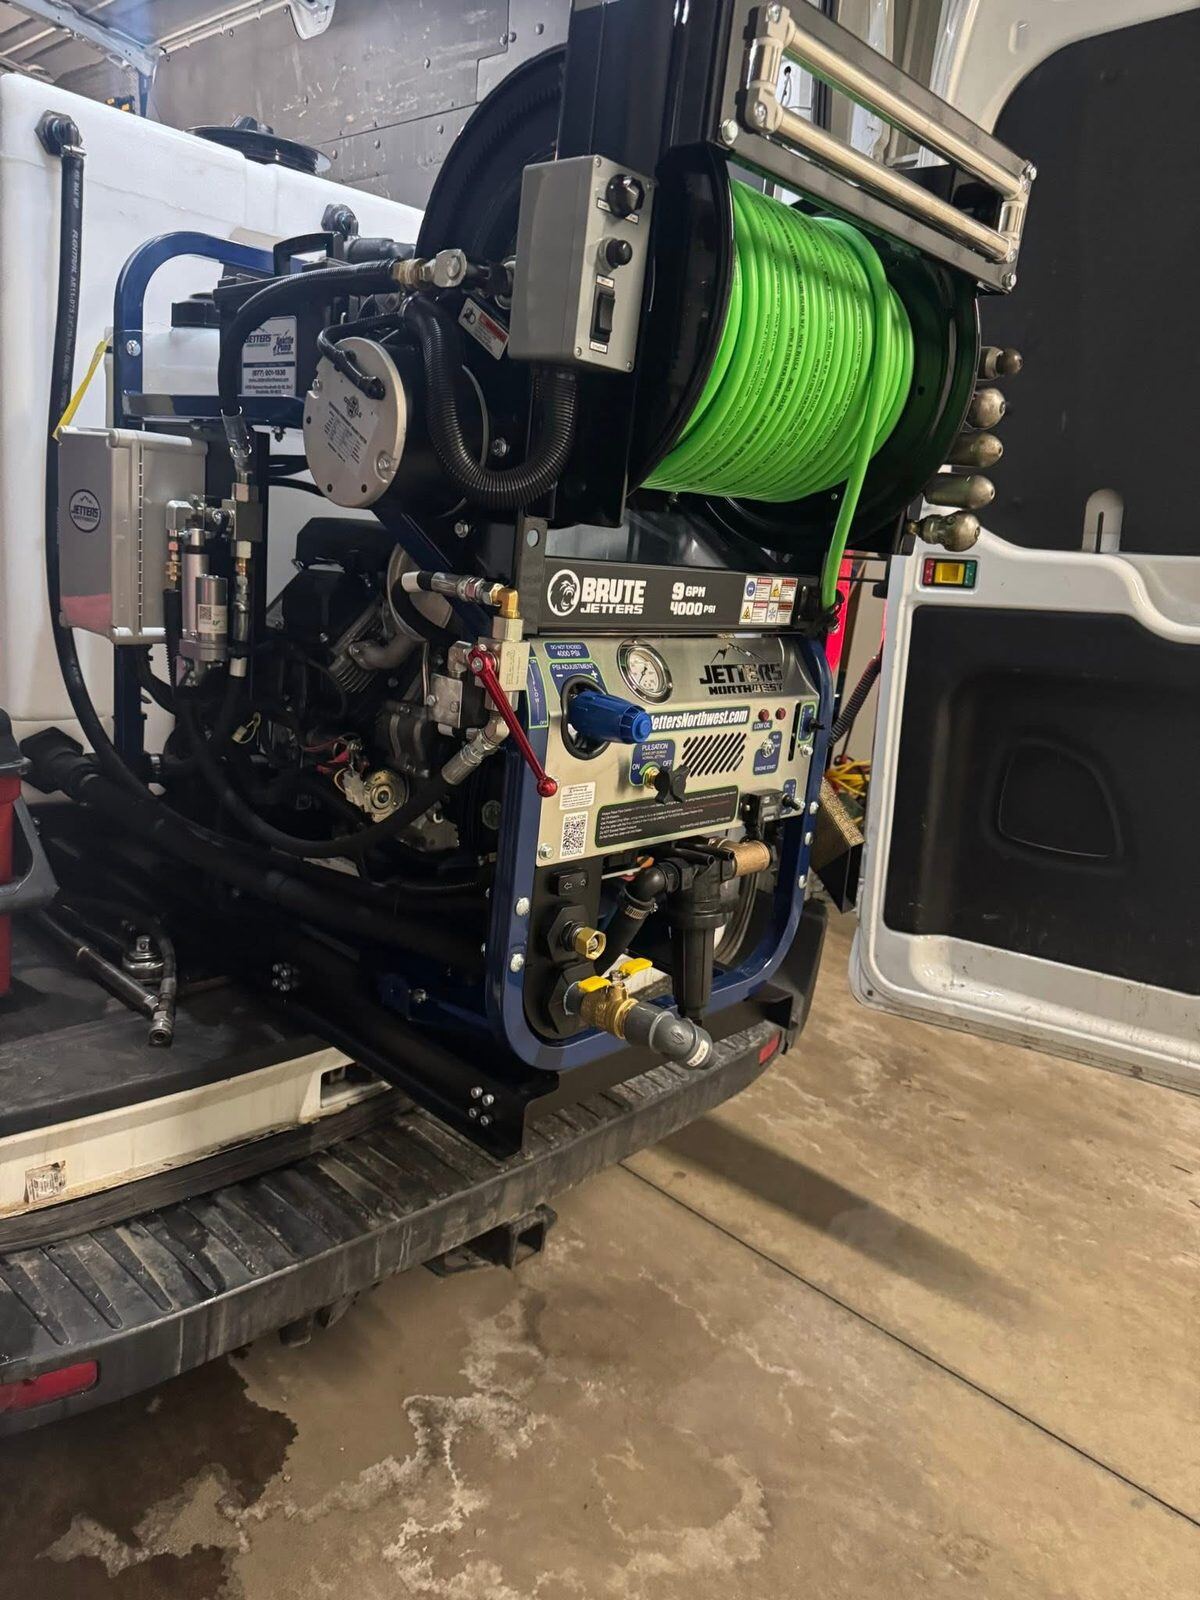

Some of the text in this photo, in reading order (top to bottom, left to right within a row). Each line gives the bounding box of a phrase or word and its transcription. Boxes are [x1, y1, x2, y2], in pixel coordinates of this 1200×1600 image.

[581, 577, 647, 604] BRUTE
[671, 582, 706, 600] 9 GPM
[580, 603, 644, 615] JETTERS
[670, 601, 716, 616] 4000 PSI
[699, 663, 783, 684] JETTERS
[708, 683, 783, 695] NORTHWEST
[642, 743, 669, 751] PULSATION
